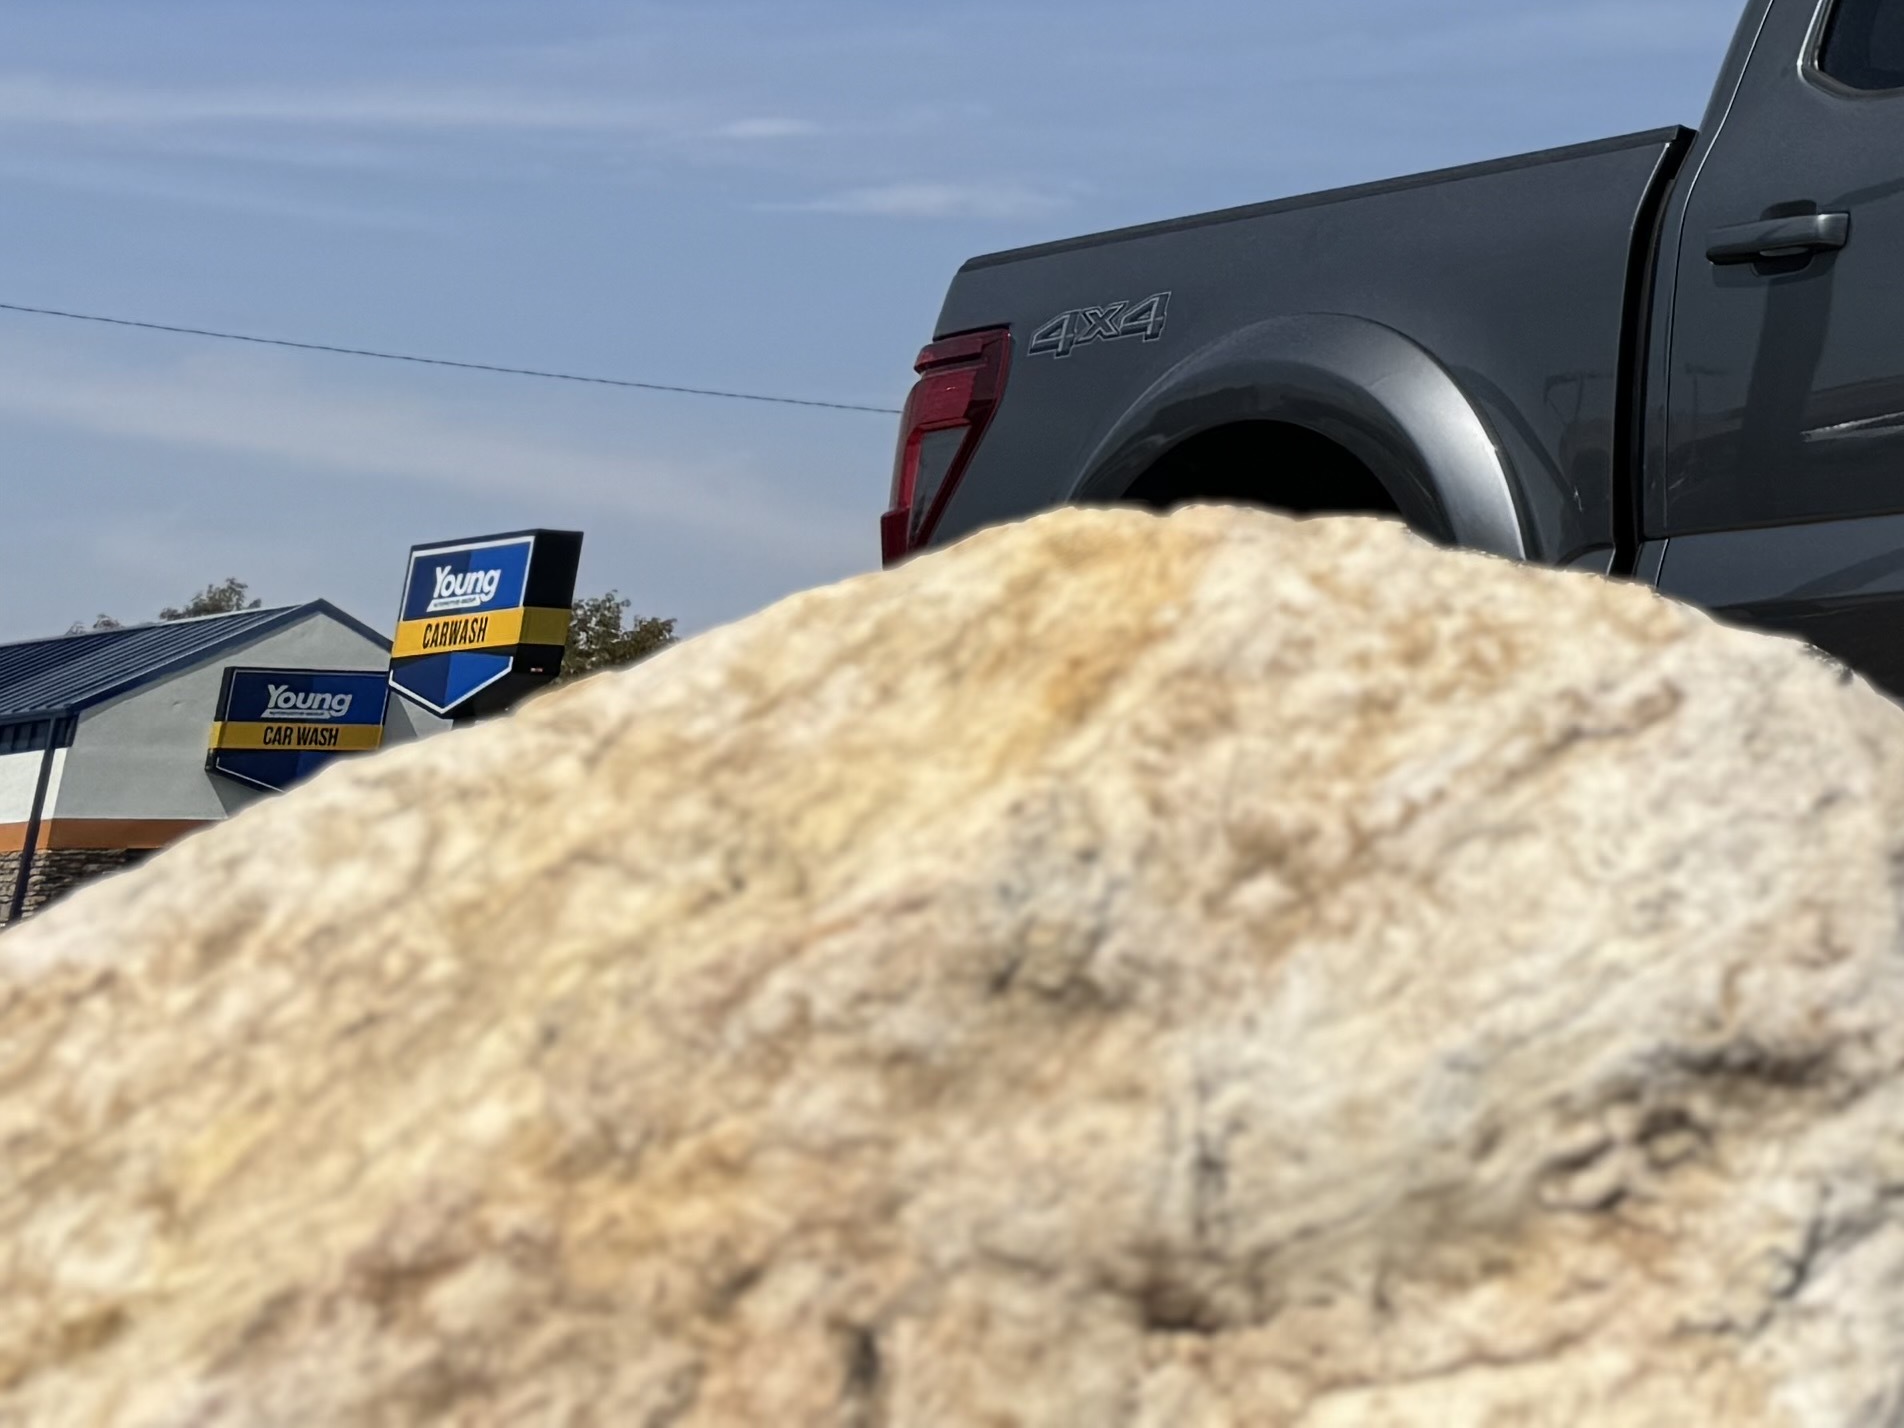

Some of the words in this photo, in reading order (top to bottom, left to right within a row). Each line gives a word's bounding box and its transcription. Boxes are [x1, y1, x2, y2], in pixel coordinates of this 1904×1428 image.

[433, 565, 501, 602] Young
[422, 616, 489, 649] CARWASH
[267, 684, 353, 717] Young
[263, 726, 293, 746] CAR
[297, 726, 339, 746] WASH
